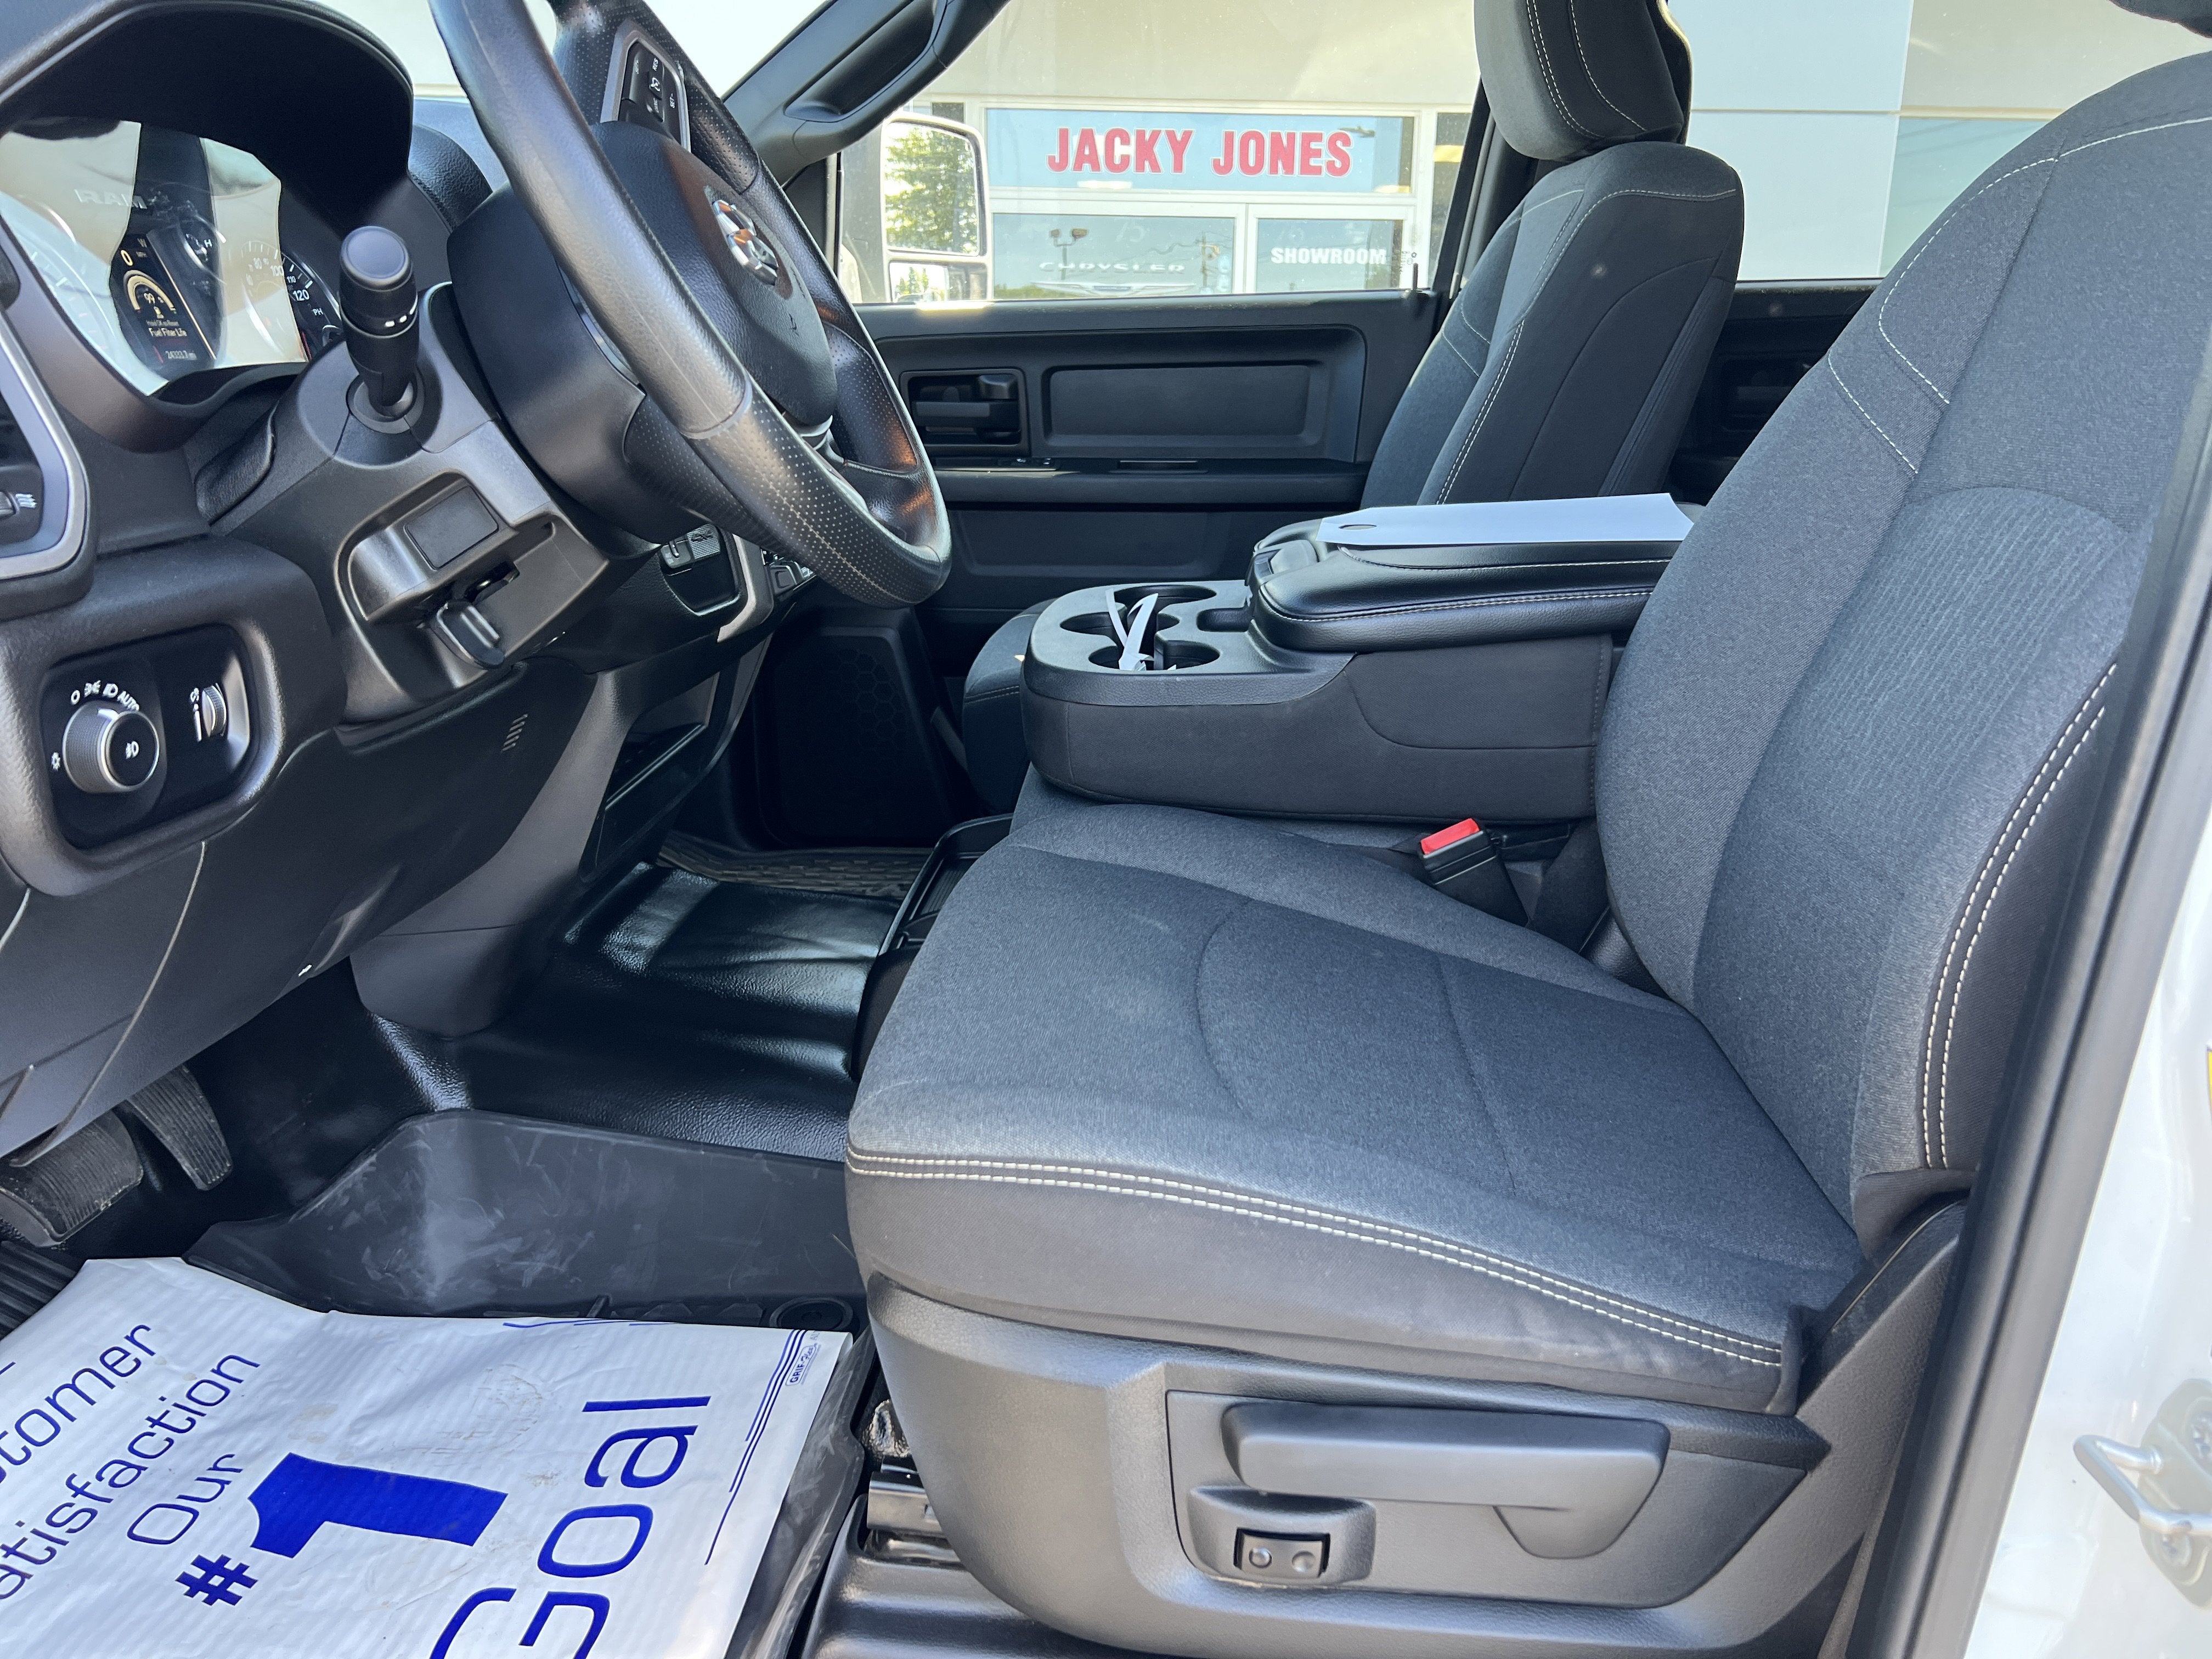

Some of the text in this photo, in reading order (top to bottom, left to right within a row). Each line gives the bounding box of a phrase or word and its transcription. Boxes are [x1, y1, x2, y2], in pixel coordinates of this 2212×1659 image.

[1046, 127, 1353, 177] JACKY JONES
[1271, 246, 1387, 264] SHOWROOM
[292, 289, 310, 302] 120
[117, 691, 140, 711] AUTO
[0, 1324, 156, 1482] tomer
[127, 1453, 244, 1545] Our
[174, 1452, 509, 1606] #1
[428, 1395, 712, 1659] Goal
